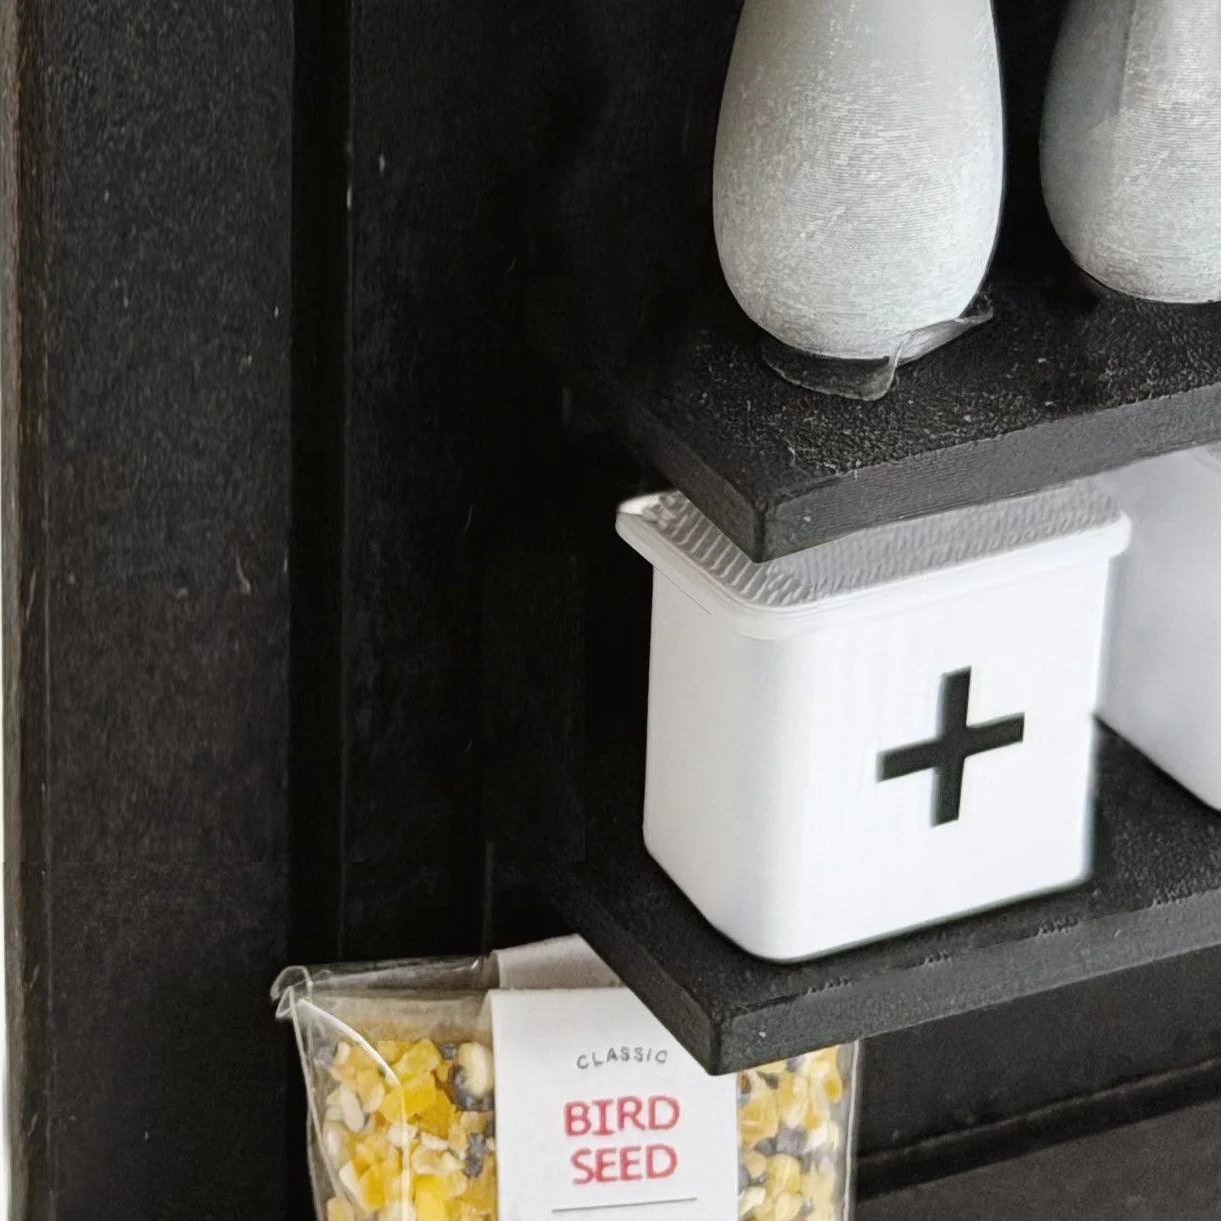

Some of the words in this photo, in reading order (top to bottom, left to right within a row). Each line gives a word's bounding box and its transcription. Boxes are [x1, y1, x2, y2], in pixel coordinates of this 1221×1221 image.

[576, 1046, 668, 1069] CLASSIC
[563, 1095, 681, 1137] BIRD
[570, 1144, 678, 1185] SEED
